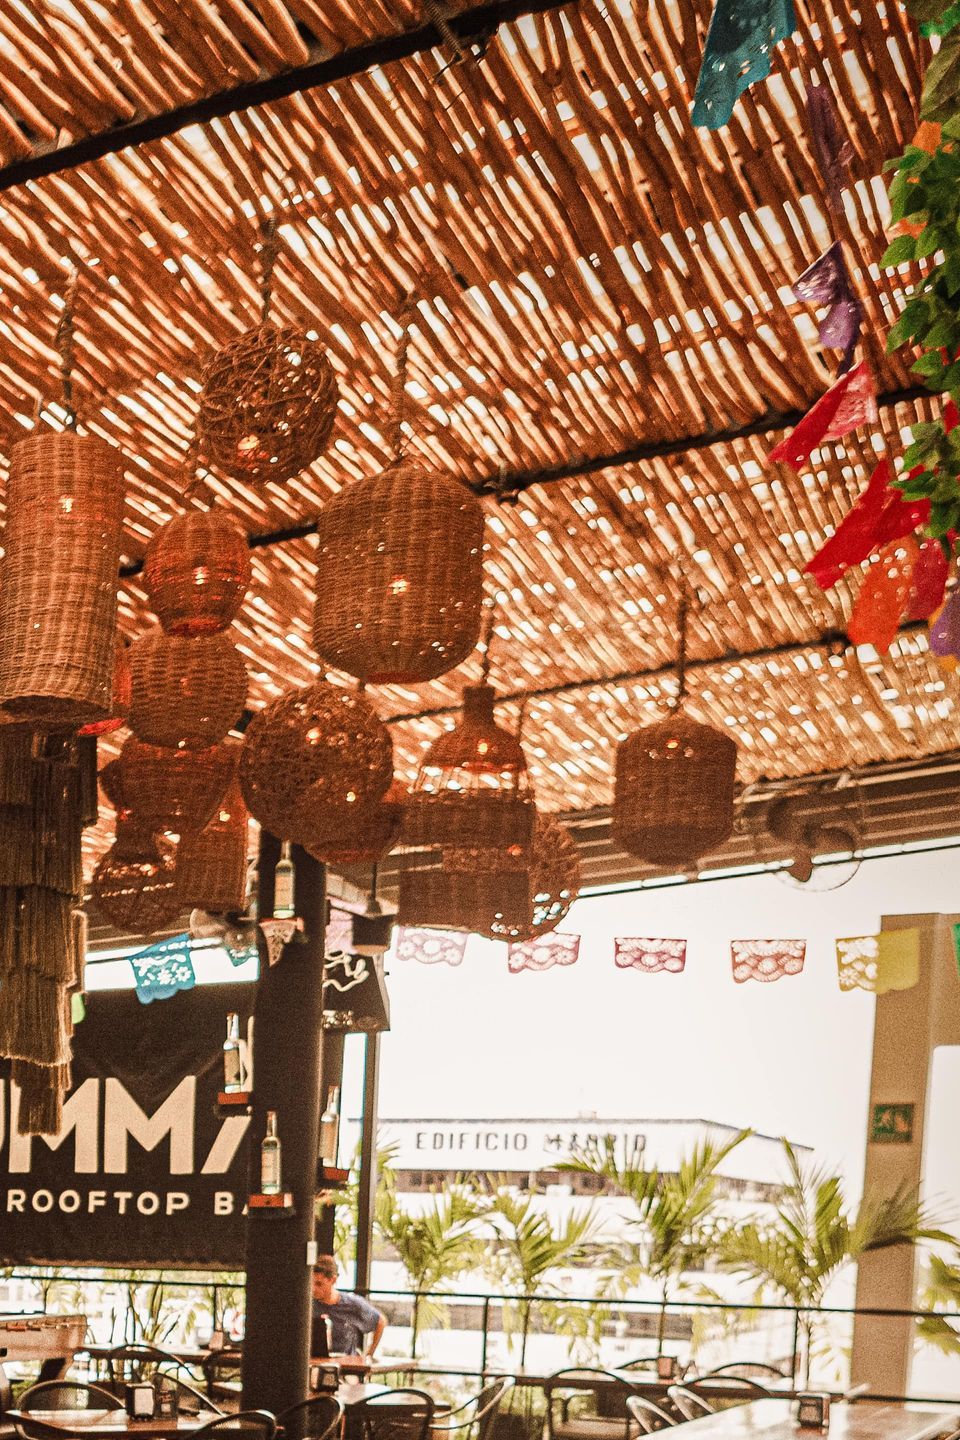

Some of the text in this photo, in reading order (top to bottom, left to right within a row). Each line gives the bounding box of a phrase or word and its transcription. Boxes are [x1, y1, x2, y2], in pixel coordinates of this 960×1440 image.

[415, 1132, 528, 1150] EDIFICIO
[6, 1189, 248, 1215] ROOFTOP B
